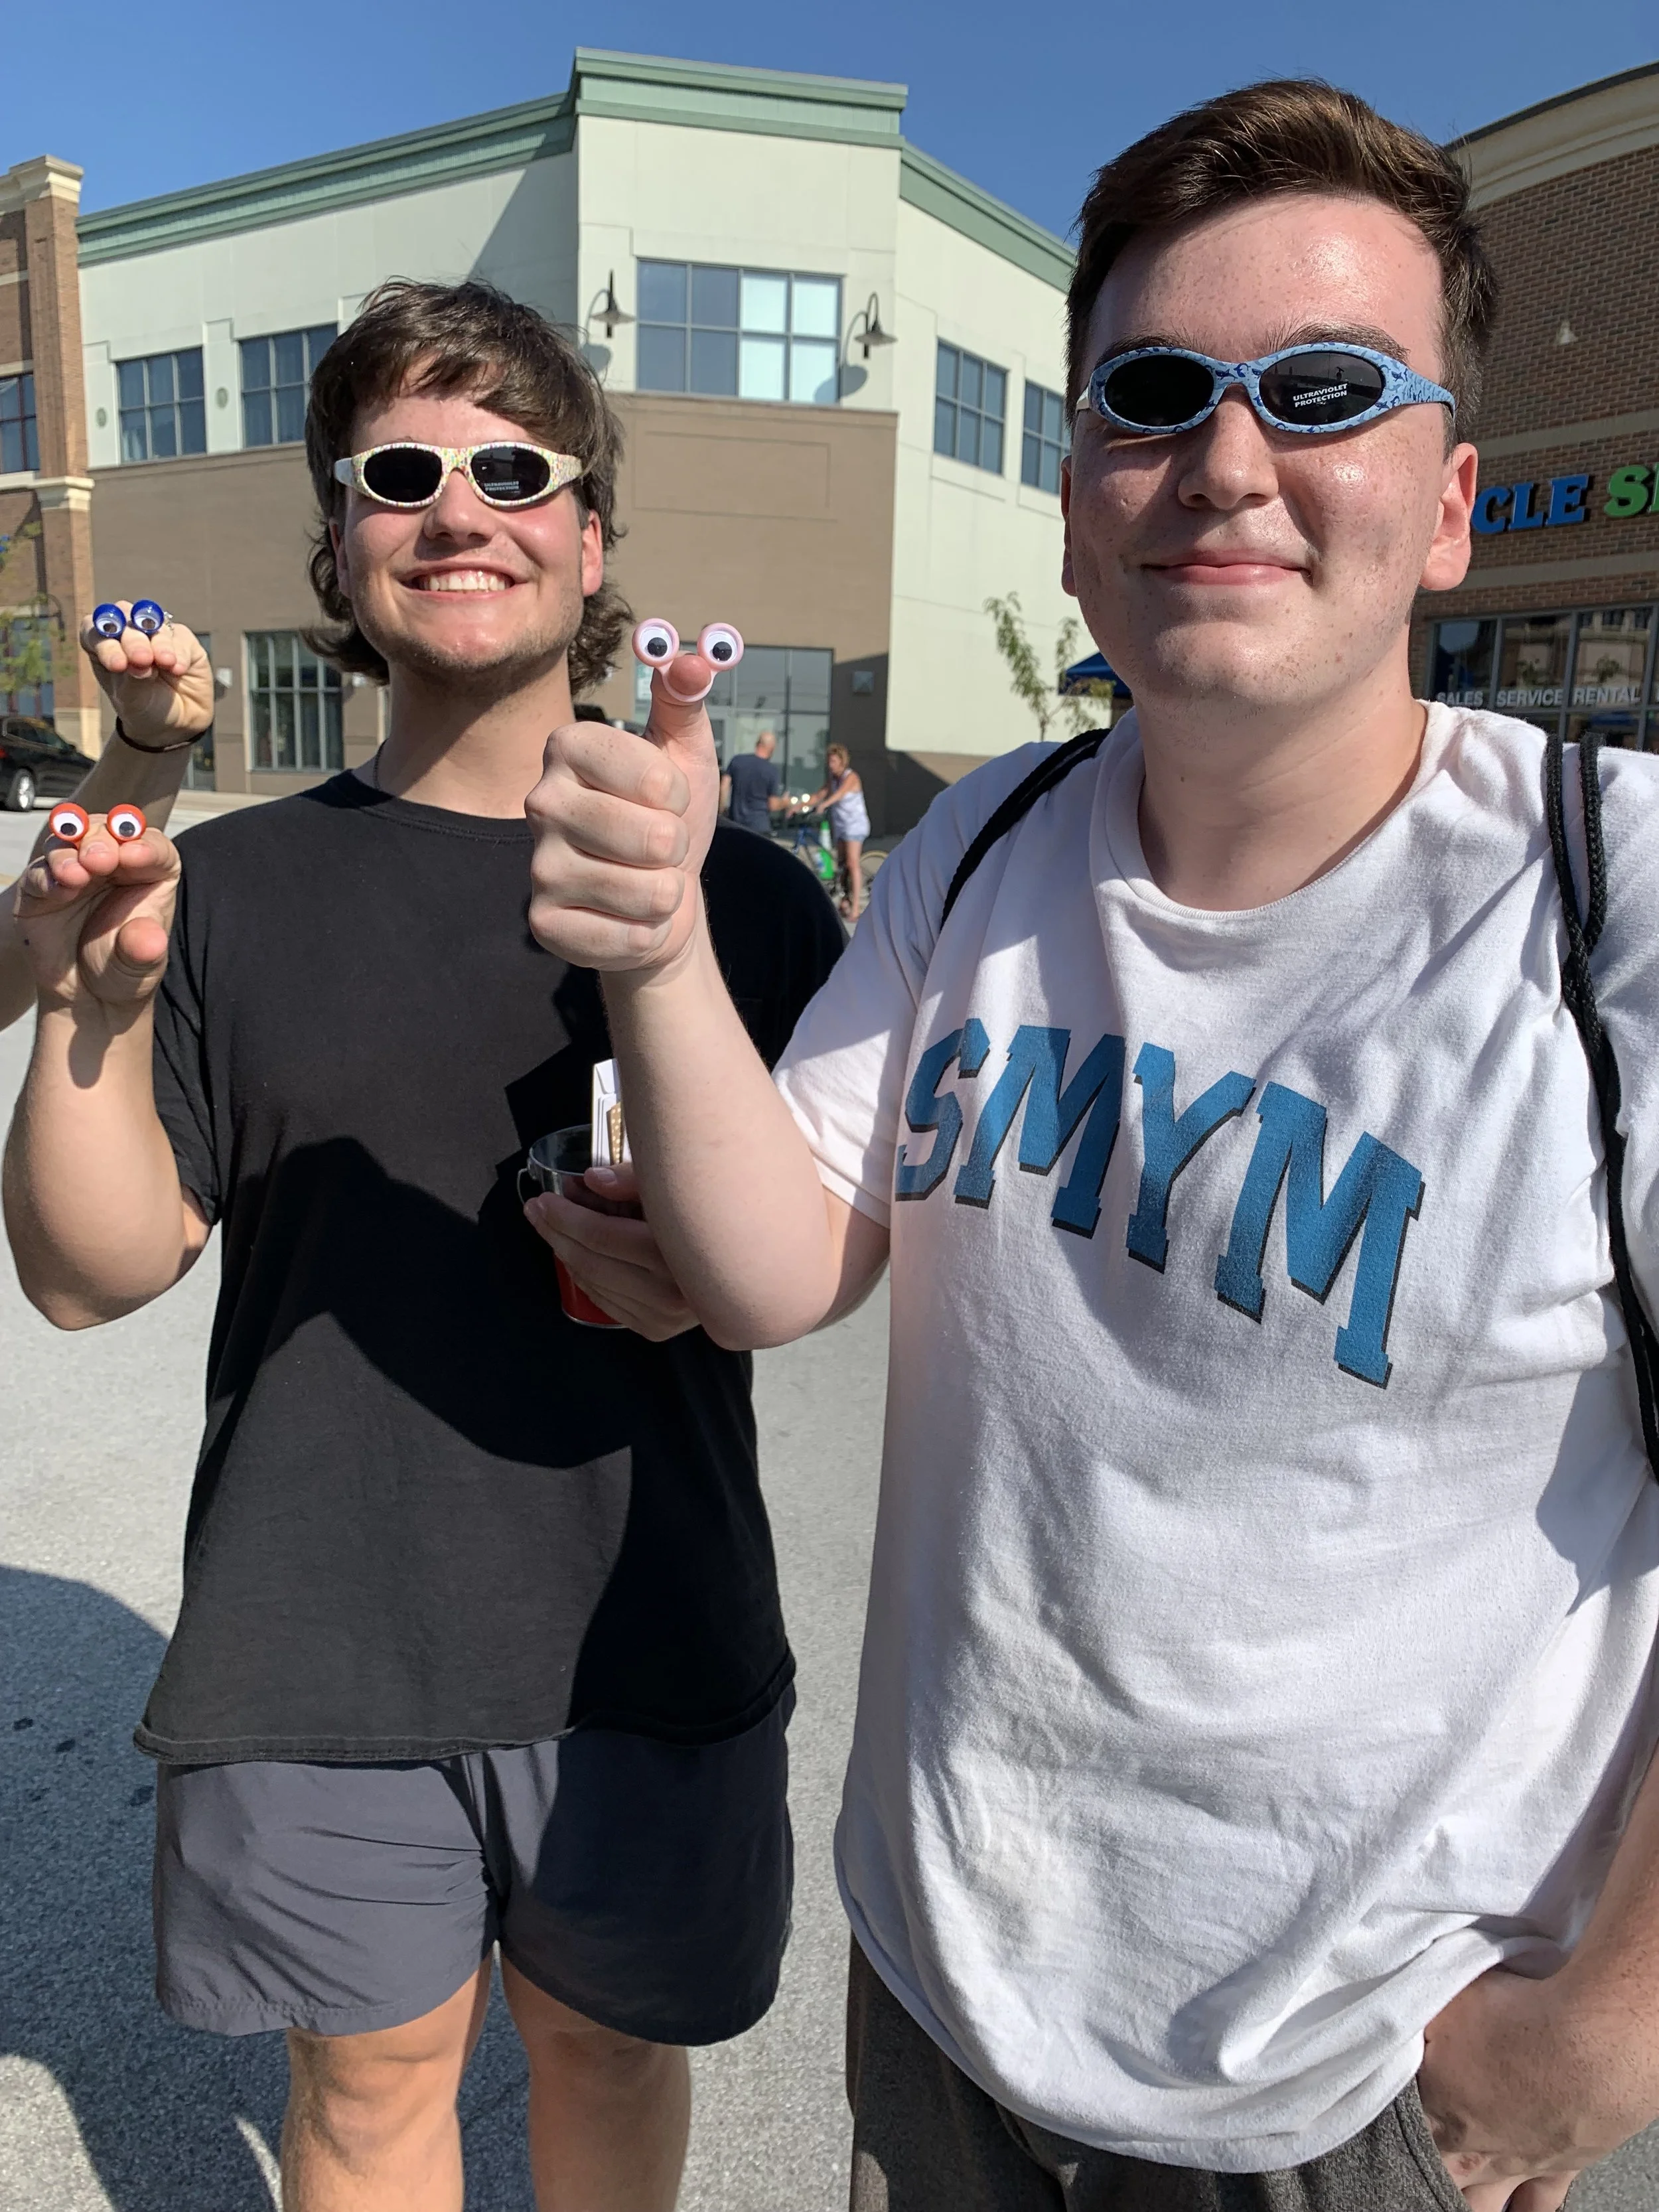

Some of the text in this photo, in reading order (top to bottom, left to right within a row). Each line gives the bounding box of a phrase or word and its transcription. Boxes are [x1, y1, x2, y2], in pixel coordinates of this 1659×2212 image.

[1293, 383, 1348, 401] ULTRAVIOLET
[1295, 390, 1348, 408] PROTECTION
[1436, 690, 1483, 706] SALES
[1496, 688, 1563, 707] SERVICE
[1572, 684, 1641, 706] RENTAL
[895, 1018, 1425, 1390] SMYM
